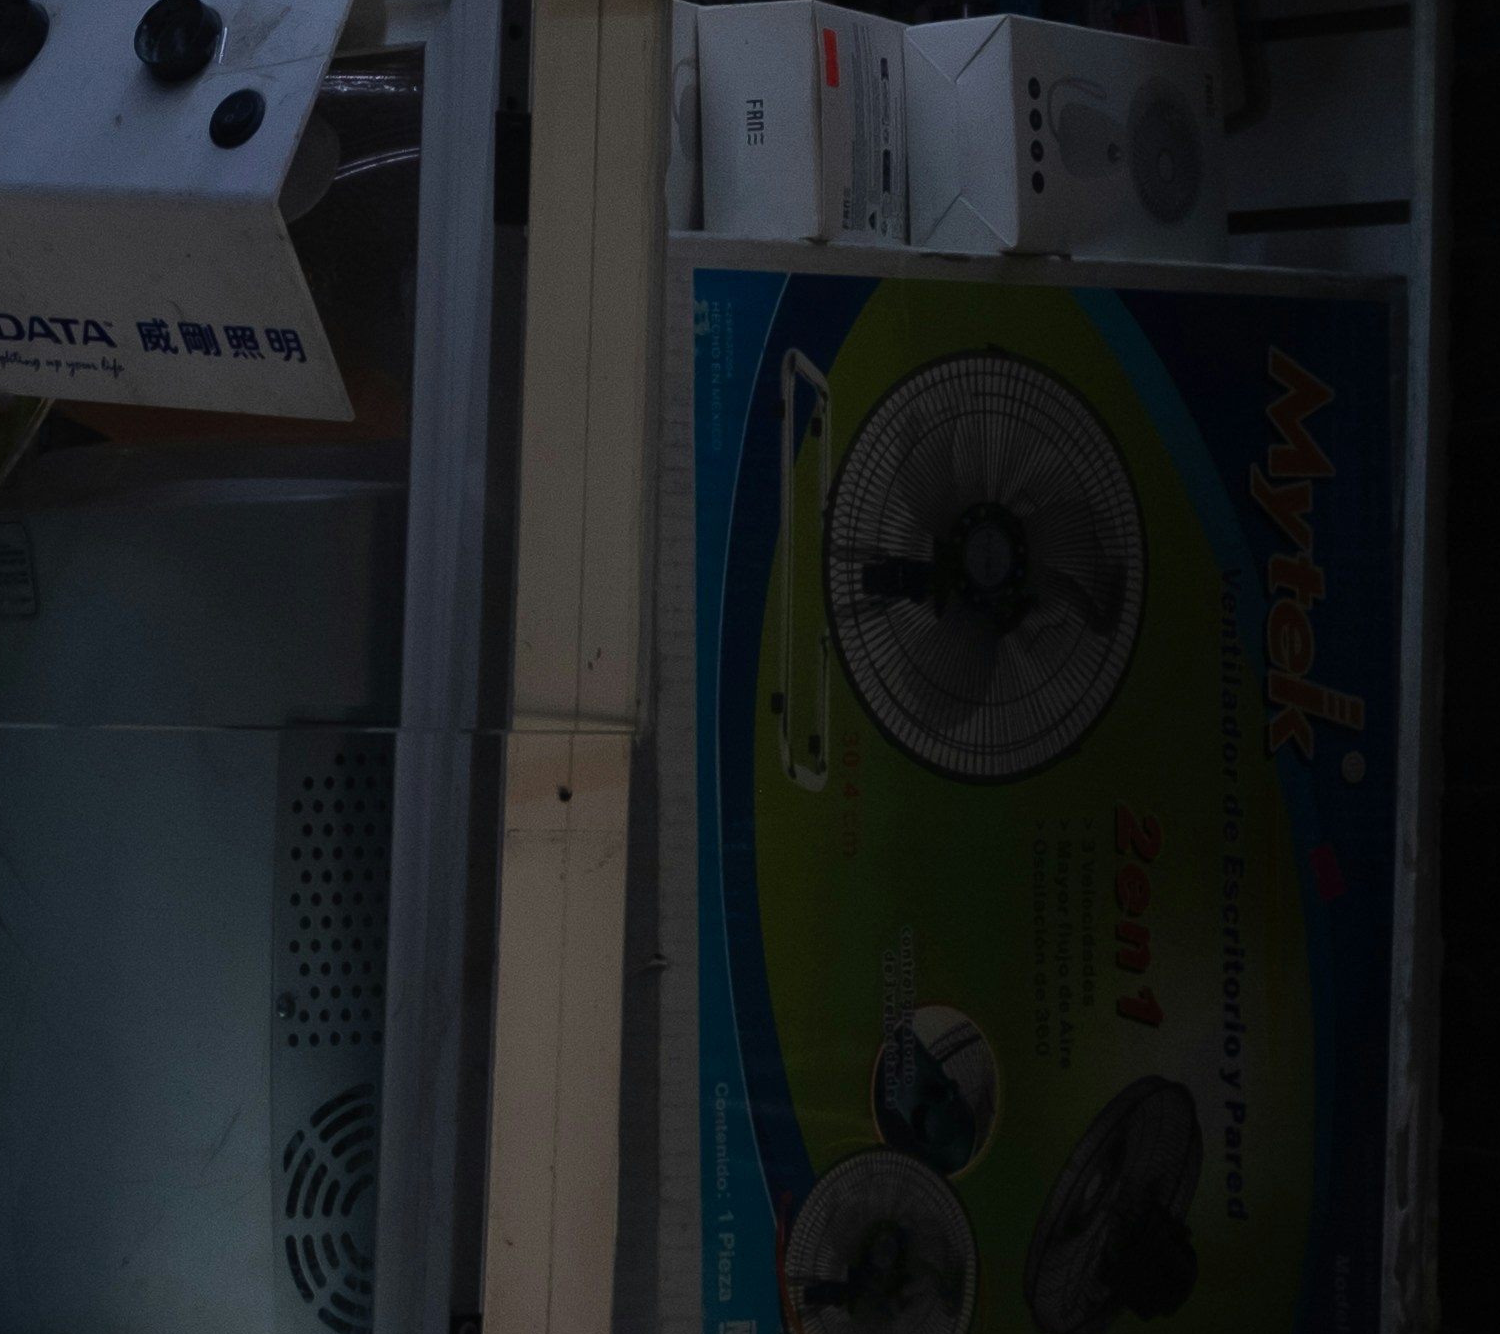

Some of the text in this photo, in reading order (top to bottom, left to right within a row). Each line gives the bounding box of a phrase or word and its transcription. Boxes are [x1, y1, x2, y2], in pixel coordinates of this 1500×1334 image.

[711, 300, 722, 359] HECHO
[711, 361, 722, 385] EN
[1249, 344, 1367, 762] Mytek
[1054, 840, 1073, 915] Mayor
[1218, 566, 1250, 1220] Ventilador de Escritorio y Pared
[1081, 838, 1096, 1008] 3 Velocidades
[1058, 984, 1074, 1014] de
[1058, 1019, 1075, 1070] Aire
[716, 1232, 736, 1302] Pieza
